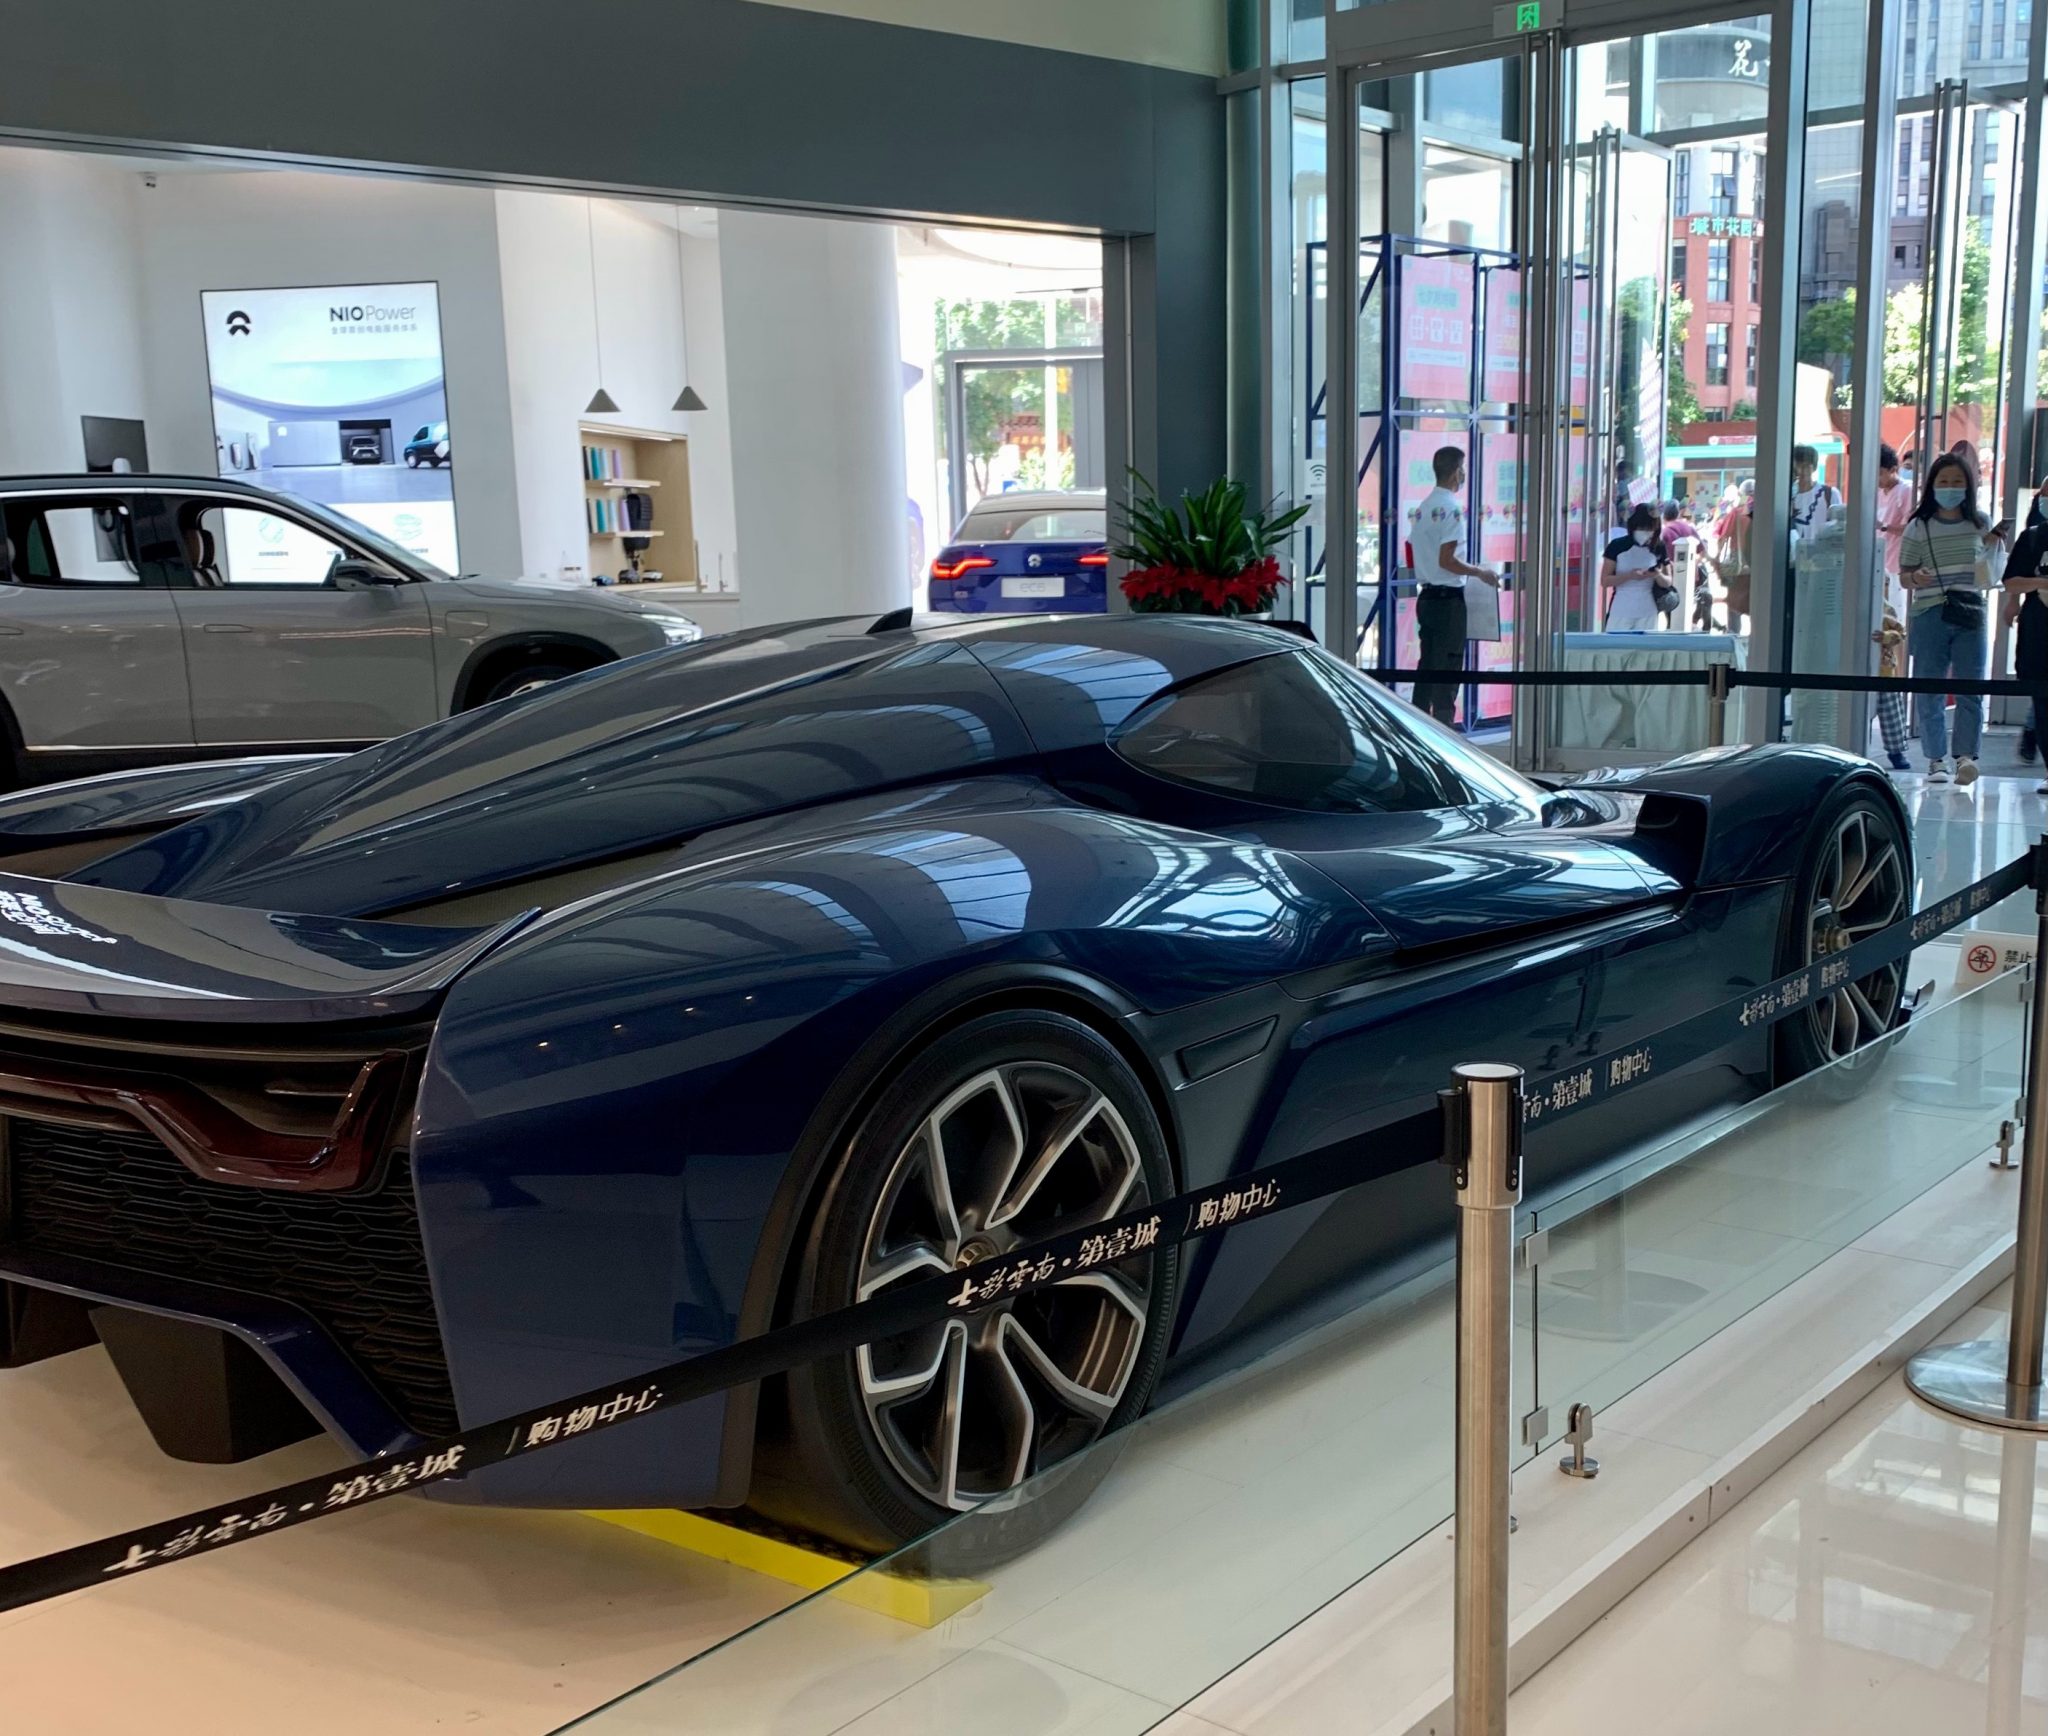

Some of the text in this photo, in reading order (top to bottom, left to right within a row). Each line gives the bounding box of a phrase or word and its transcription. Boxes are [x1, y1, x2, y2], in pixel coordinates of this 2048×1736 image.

[1610, 1047, 1653, 1087] 购物中心
[1194, 1178, 1282, 1231] 购物中心
[523, 1384, 664, 1448] 购物中心
